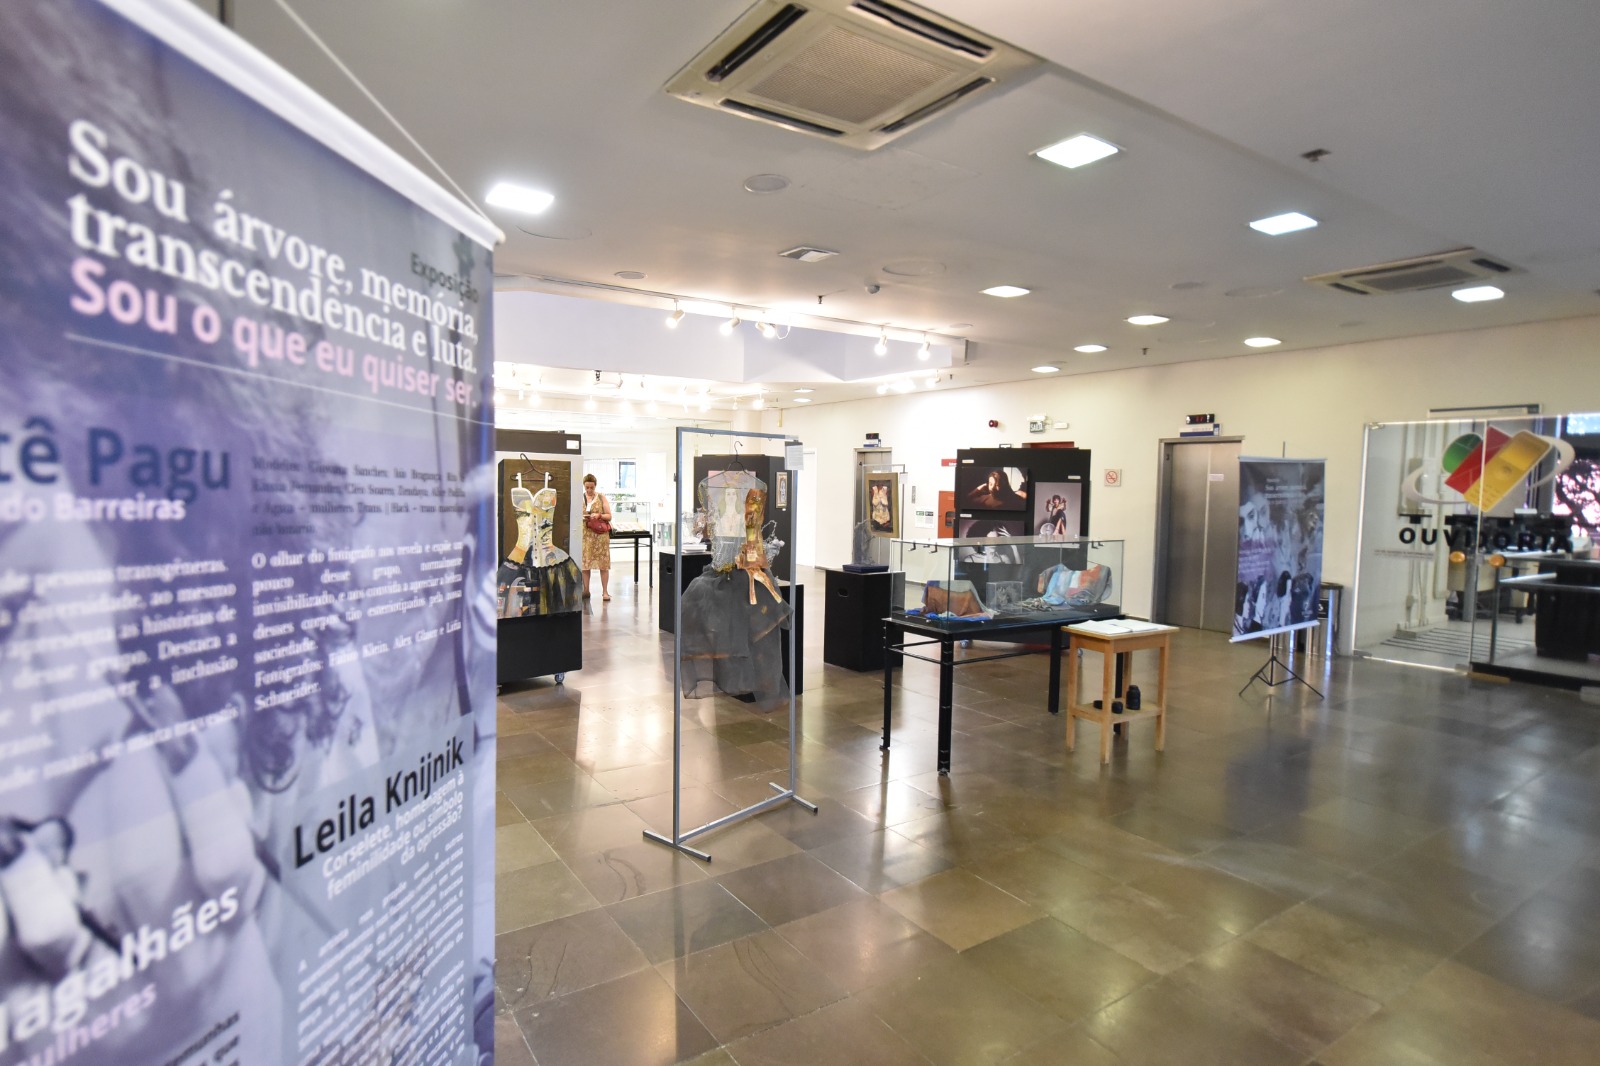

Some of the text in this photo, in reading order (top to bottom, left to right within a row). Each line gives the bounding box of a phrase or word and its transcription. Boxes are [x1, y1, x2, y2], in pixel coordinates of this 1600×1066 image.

[68, 119, 479, 346] Sou árvore, memória,
[67, 193, 478, 374] transcendência e luta.
[411, 252, 479, 303] Exposição
[71, 256, 478, 408] Sou o que eu quiser ser.
[54, 491, 187, 521] Barreiras
[88, 427, 230, 506] Pagu
[252, 552, 267, 569] O
[269, 549, 303, 568] olhar
[294, 735, 464, 869] Leila Knijnik
[322, 823, 393, 878] Corselete,
[327, 829, 412, 900] feminilidade
[0, 886, 240, 1054] agalhães
